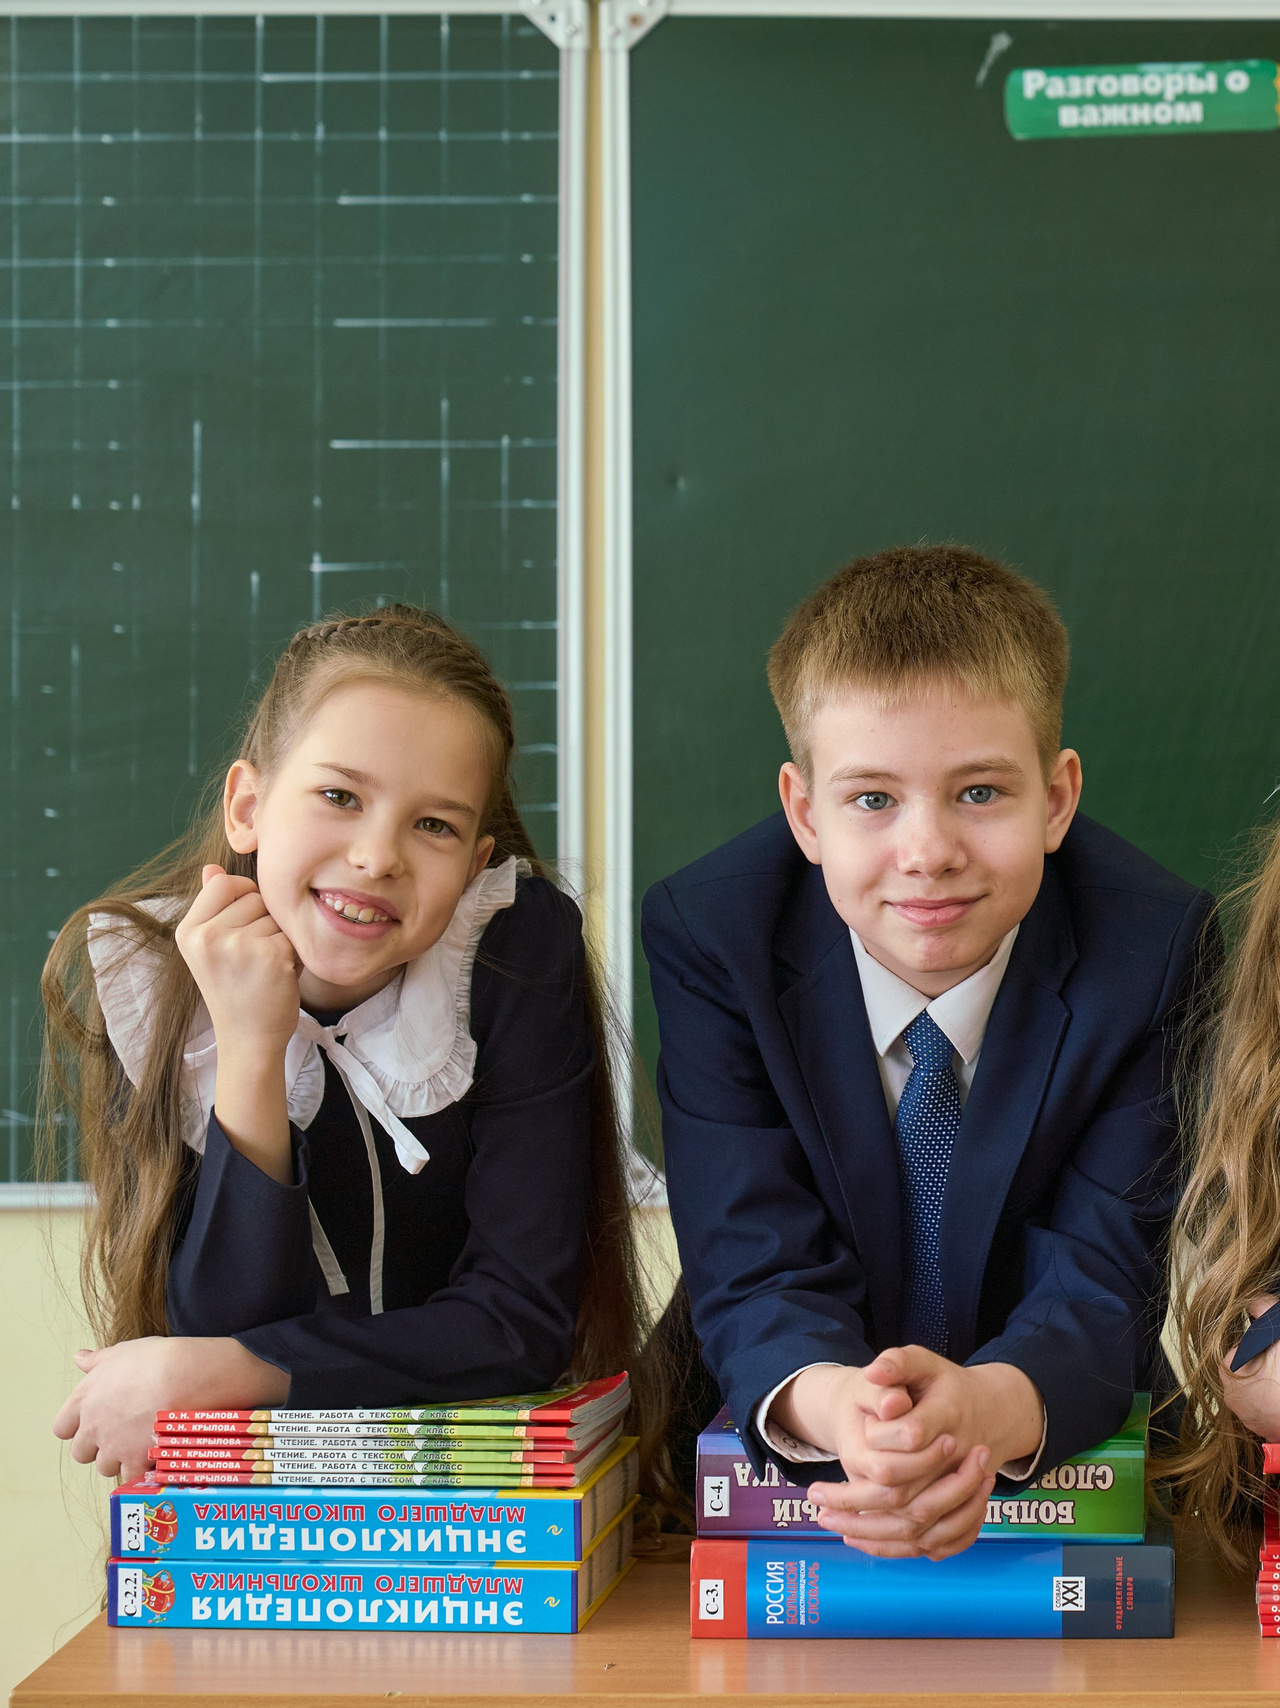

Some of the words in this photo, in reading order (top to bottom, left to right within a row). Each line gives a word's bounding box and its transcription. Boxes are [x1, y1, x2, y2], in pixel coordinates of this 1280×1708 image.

[1022, 69, 1218, 102] Разговоры
[1224, 69, 1250, 94] о
[1058, 102, 1204, 128] важном
[166, 1424, 175, 1432] О.
[177, 1424, 187, 1432] Н.
[192, 1424, 236, 1432] КРЫЛОВА
[168, 1412, 178, 1420] О.
[180, 1412, 189, 1420] Н.
[194, 1412, 239, 1420] КРЫЛОВА
[160, 1450, 170, 1458] О.
[172, 1450, 182, 1458] Н.
[186, 1450, 231, 1458] КРЫЛОВА
[196, 1438, 241, 1446] КРЫЛОВА
[322, 1439, 357, 1447] РАБОТА
[170, 1461, 179, 1469] О.
[181, 1461, 191, 1469] Н.
[196, 1461, 241, 1469] КРЫЛОВА
[1028, 1463, 1115, 1491] СЛОВ
[193, 1503, 365, 1522] ШКОЛЬНИКА
[377, 1502, 526, 1523] МЛАДШЕГО
[195, 1523, 527, 1553] ЭНЦИКЛОПЕДИЯ
[191, 1573, 363, 1592] ШКОЛЬНИКА
[375, 1574, 523, 1594] МЛАДШЕГО
[766, 1561, 784, 1624] РОССИЯ
[785, 1561, 798, 1624] БОЛЬШОЙ
[807, 1562, 820, 1624] СЛОВАРЬ
[1062, 1581, 1079, 1607] XXI
[1115, 1556, 1124, 1630] ФУНДАМЕНТАЛЬНЫЕ
[1126, 1577, 1134, 1610] СЛОВАРИ
[192, 1593, 523, 1626] ЭНЦИКЛОПЕДИЯ
